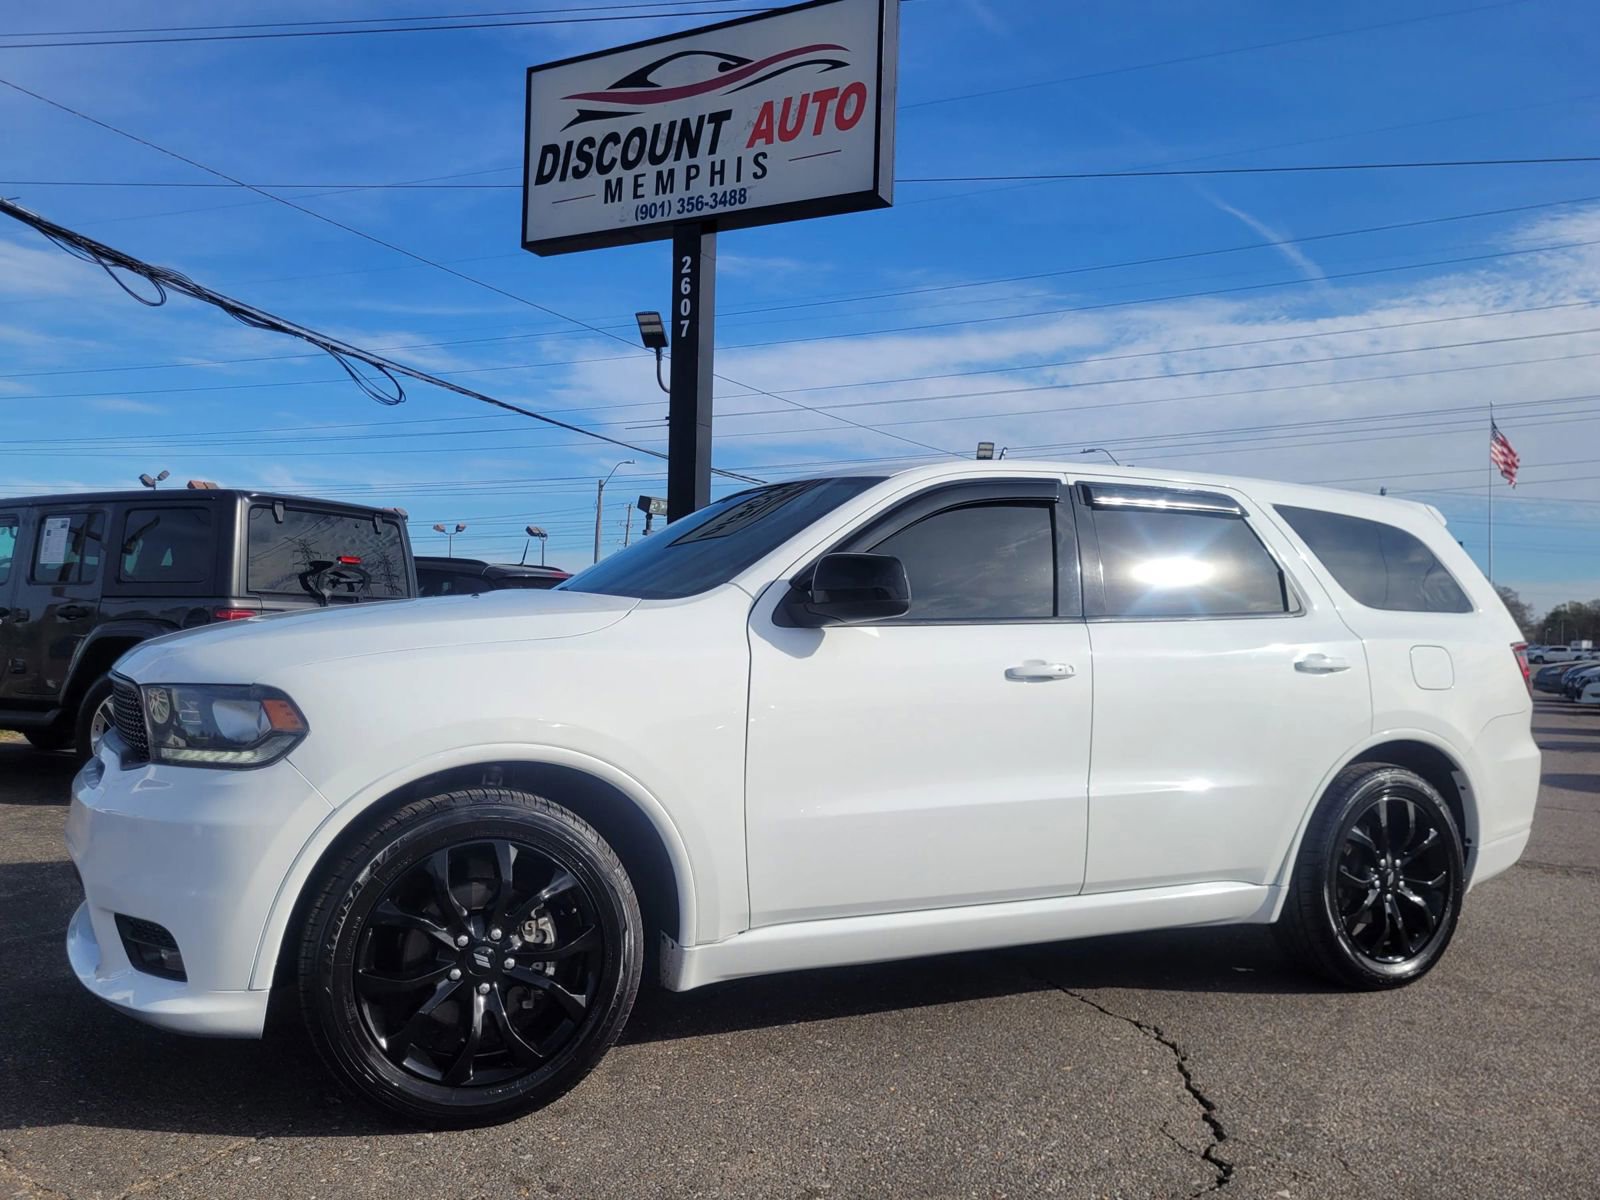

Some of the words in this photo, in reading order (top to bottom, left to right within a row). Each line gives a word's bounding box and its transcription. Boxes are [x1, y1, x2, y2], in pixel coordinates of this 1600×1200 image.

[534, 109, 733, 186] DISCOUNT
[745, 81, 867, 149] AUTO
[603, 152, 768, 204] MEMPHIS
[635, 200, 672, 221] (901)
[677, 188, 747, 215] 356-3488
[680, 255, 692, 338] 2607
